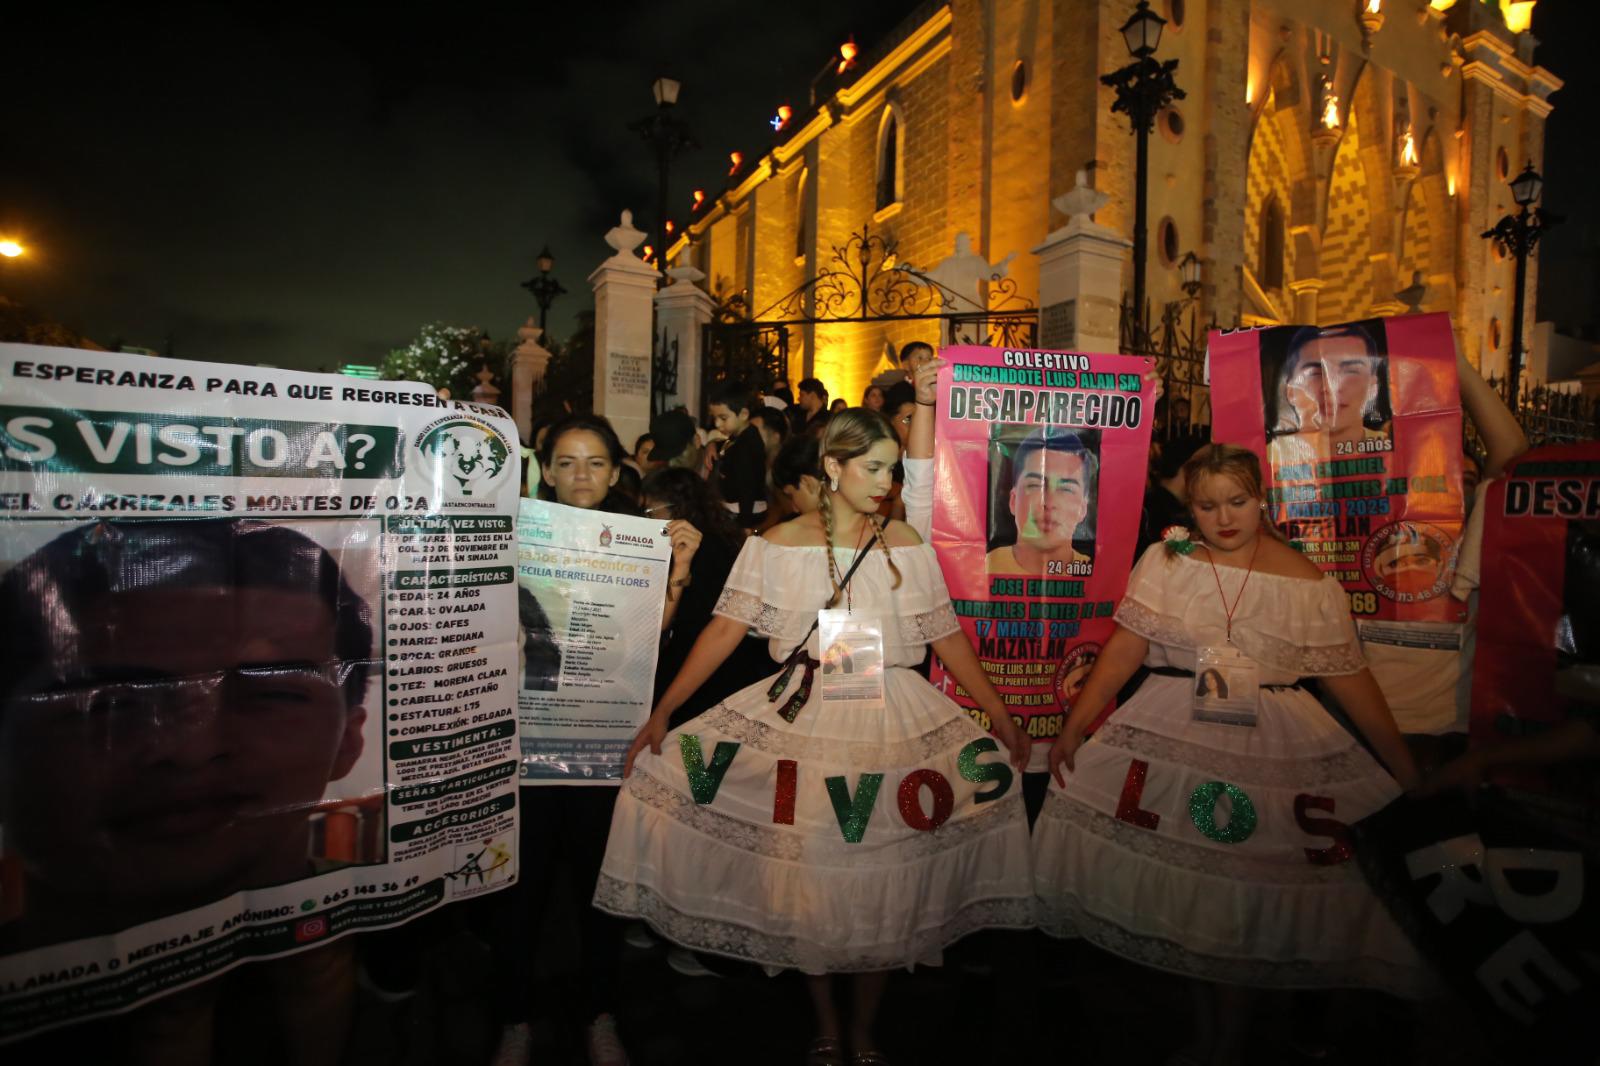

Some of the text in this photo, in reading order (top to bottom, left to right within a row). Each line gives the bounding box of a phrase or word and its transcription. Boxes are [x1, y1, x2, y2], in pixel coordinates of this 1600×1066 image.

[1003, 350, 1090, 371] COLECTIVO
[13, 360, 195, 390] ESPERANZA
[206, 378, 278, 398] PARA
[287, 384, 333, 400] QUE
[342, 387, 447, 408] REGRESEN
[454, 401, 466, 411] A
[953, 364, 1142, 392] BUSCANDOTE LUIS ALAN SM
[949, 386, 1142, 430] DESAPARECIDO
[76, 419, 289, 468] VISTO
[304, 431, 376, 470] A?
[1336, 438, 1393, 455] 24 años
[1316, 457, 1387, 479] EMANUEL
[1320, 480, 1381, 500] MONTES
[1385, 478, 1408, 495] DE
[53, 493, 236, 512] CARRIZALES
[246, 495, 342, 511] MONTES
[349, 496, 377, 510] DE
[385, 496, 429, 510] OCA
[1286, 498, 1390, 518] MARZO 2025
[454, 519, 476, 529] VEZ
[478, 519, 506, 529] VISTO:
[517, 527, 553, 540] inaloa
[615, 533, 654, 545] SINALOA
[454, 544, 497, 552] NOVIEMBRE
[1345, 541, 1360, 551] SM
[467, 553, 498, 562] SINALOA
[575, 557, 638, 572] encontrar
[1048, 561, 1093, 577] 24 años
[400, 571, 509, 586] CARACTERÍSTICAS:
[555, 570, 614, 585] BERRELLEZA
[615, 578, 650, 588] FLORES
[990, 578, 1086, 597] JOSE EMANUEL
[437, 590, 450, 600] 24
[454, 588, 480, 598] AÑOS
[1376, 583, 1396, 600] 638
[439, 603, 486, 614] OVALADA
[953, 599, 1025, 619] ARRIZALES
[1029, 602, 1079, 620] MONTES
[399, 619, 469, 631] OJOS: CAFES
[975, 620, 992, 637] 17
[996, 621, 1044, 638] MARZO
[399, 631, 484, 646] NARIZ: MEDIANA
[400, 646, 477, 661] BOCA: GRANDE
[978, 638, 1067, 660] MAZATLAN
[400, 658, 488, 676] LABIOS: GRUESOS
[1007, 662, 1024, 675] LUIS
[1044, 663, 1056, 675] SM
[401, 668, 507, 691] TEZ: MORENA CLARA
[1005, 676, 1028, 686] PUERTO
[400, 683, 499, 706] CABELLO: CASTAÑO
[1005, 693, 1023, 705] LUIS
[1042, 693, 1054, 705] SM
[400, 701, 480, 721] ESTATURA: 1.75
[400, 717, 470, 736] COMPLEXIÓN:
[472, 708, 513, 724] DELGADA
[411, 728, 502, 754] VESTIMENTA:
[395, 758, 437, 768] CHAMARRA
[397, 786, 436, 799] SEÑAS
[679, 733, 1014, 844] VIVOS
[412, 803, 501, 836] ACCESORIOS:
[1115, 758, 1355, 865] LOS
[108, 959, 120, 970] O
[128, 926, 214, 963] MENSAJE
[221, 905, 295, 932] ANÓNIMO:
[354, 884, 376, 895] 148
[382, 882, 399, 892] 36
[404, 875, 420, 888] 49
